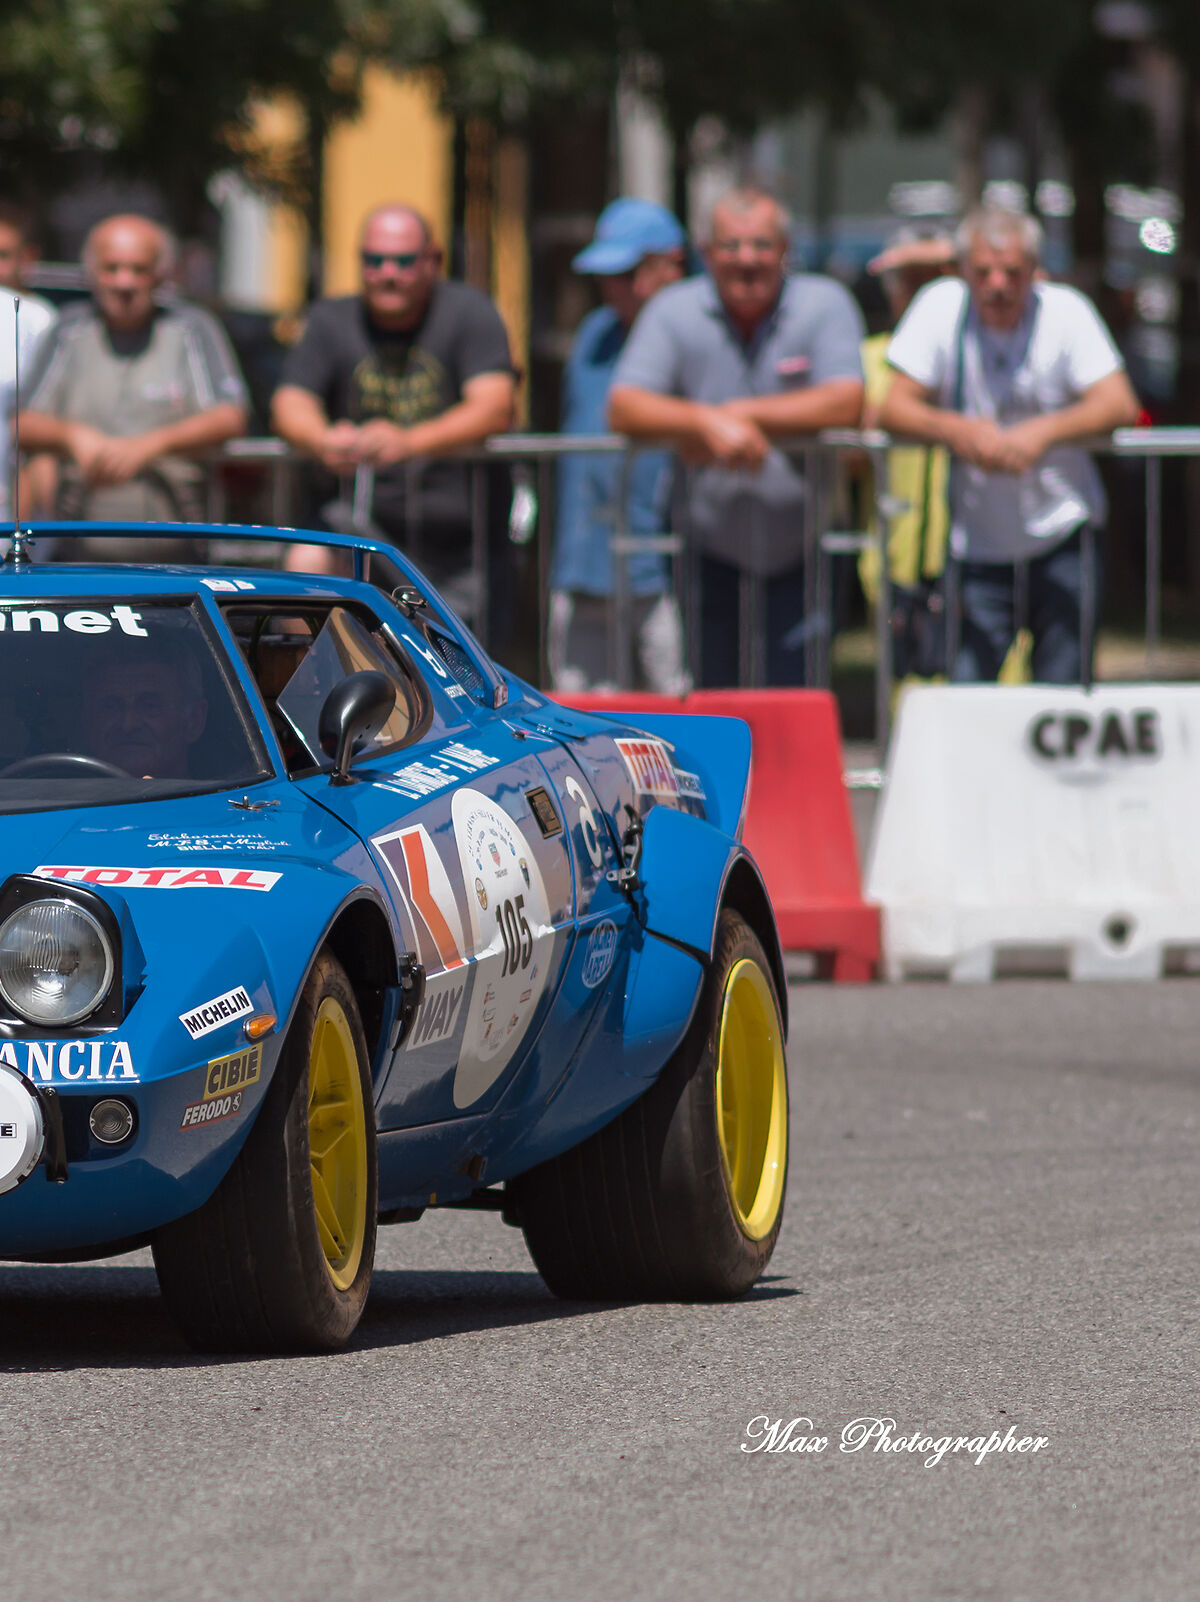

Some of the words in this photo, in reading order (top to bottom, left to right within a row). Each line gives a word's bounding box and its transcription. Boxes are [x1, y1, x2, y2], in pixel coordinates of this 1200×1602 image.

[1031, 711, 1157, 760] CPAE
[41, 867, 267, 888] TOTAL
[495, 894, 533, 978] 105
[184, 990, 250, 1033] MICHELIN
[181, 1096, 232, 1127] FERODO
